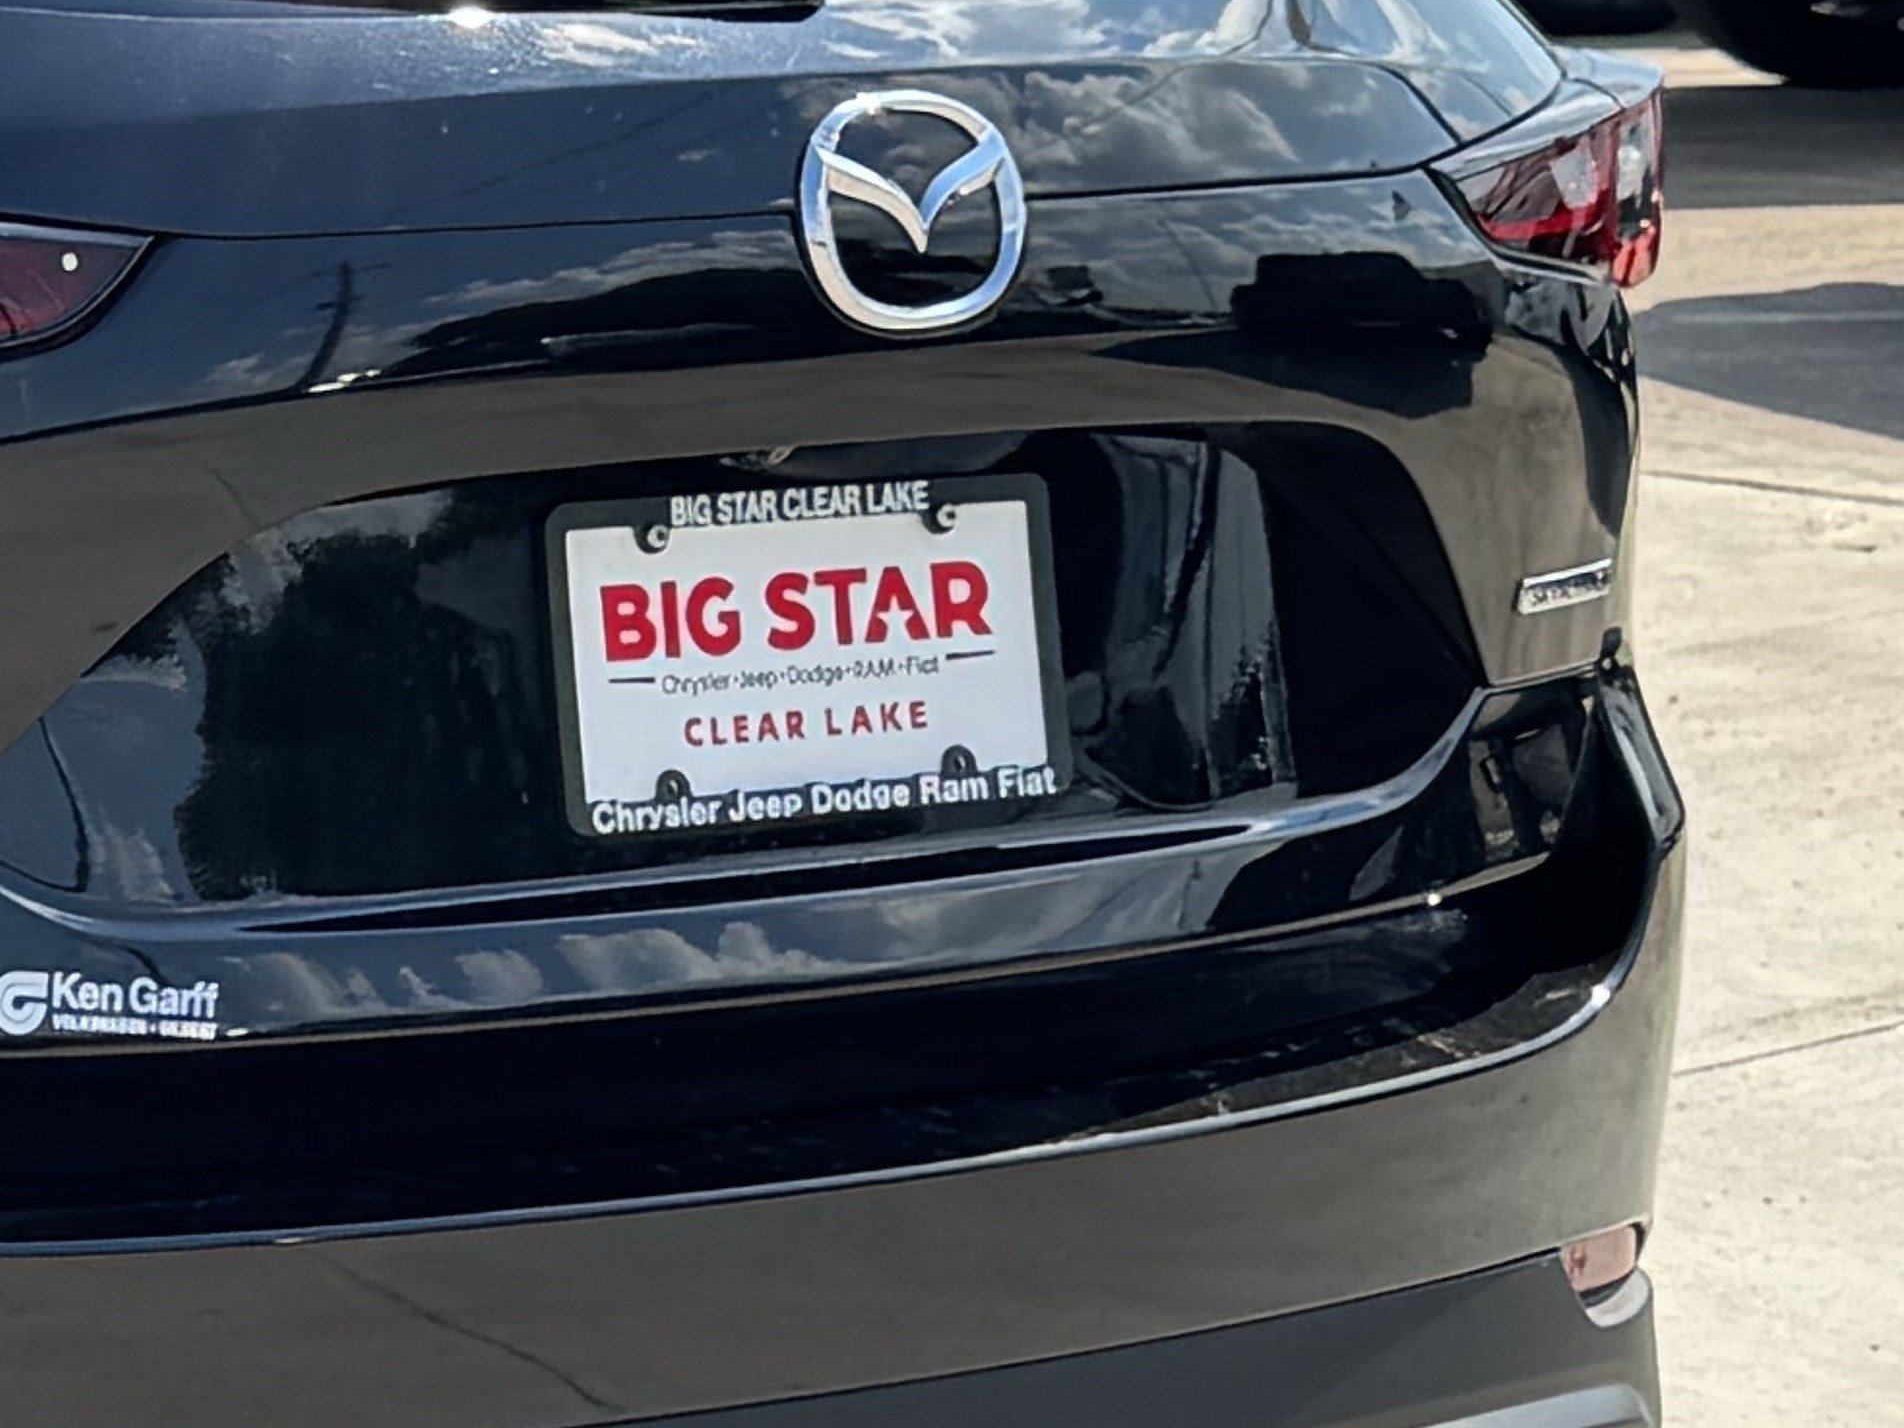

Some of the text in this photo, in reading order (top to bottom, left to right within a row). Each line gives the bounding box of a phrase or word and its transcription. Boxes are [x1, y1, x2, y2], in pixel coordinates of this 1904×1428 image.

[671, 480, 930, 525] BIG STAR CLEAR LAKE
[599, 561, 993, 662] BIG STAR
[684, 699, 929, 747] CLEAR LAKE
[592, 766, 1057, 835] Chrysler Jeep Dodge Ram Fiat
[52, 971, 220, 1019] Ken Garff
